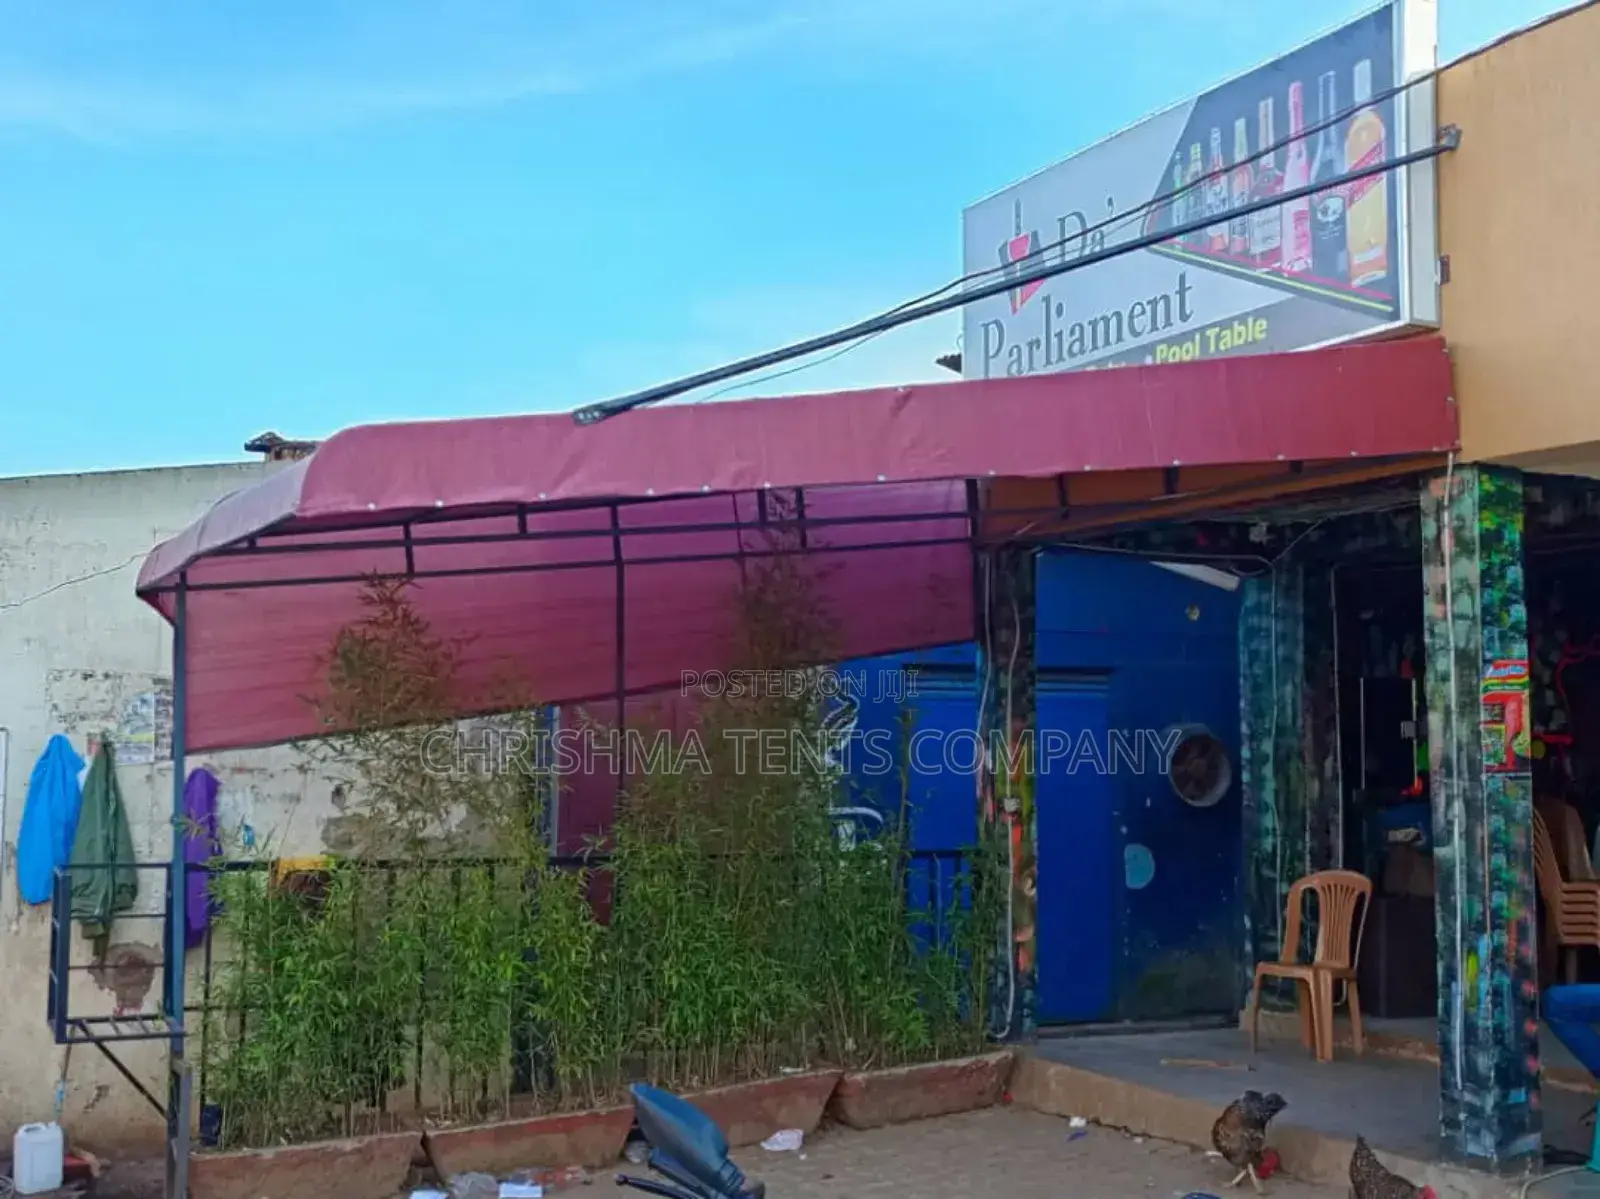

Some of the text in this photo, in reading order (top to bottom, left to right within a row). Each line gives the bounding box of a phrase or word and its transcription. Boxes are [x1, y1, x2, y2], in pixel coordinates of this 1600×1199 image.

[980, 271, 1194, 379] Parliament
[1155, 317, 1268, 364] Pool Table
